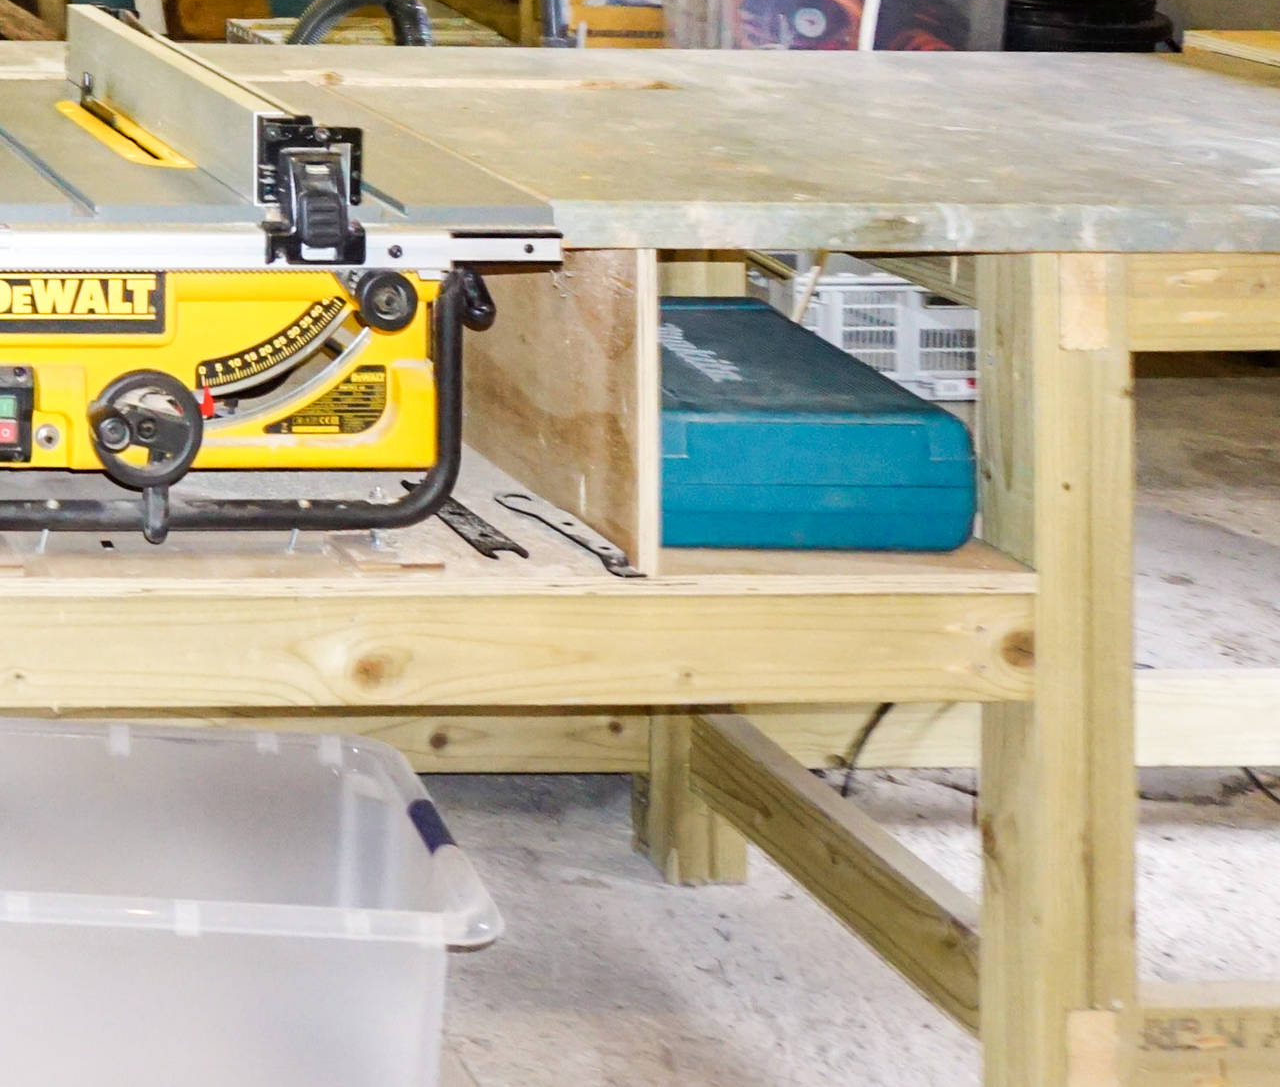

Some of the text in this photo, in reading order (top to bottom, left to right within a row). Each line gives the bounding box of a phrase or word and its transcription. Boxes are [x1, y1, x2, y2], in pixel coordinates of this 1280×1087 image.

[198, 366, 207, 375] 0
[215, 363, 224, 373] 5
[228, 358, 243, 369] 10
[244, 351, 258, 362] 15
[258, 344, 273, 356] 20
[273, 336, 288, 349] 25
